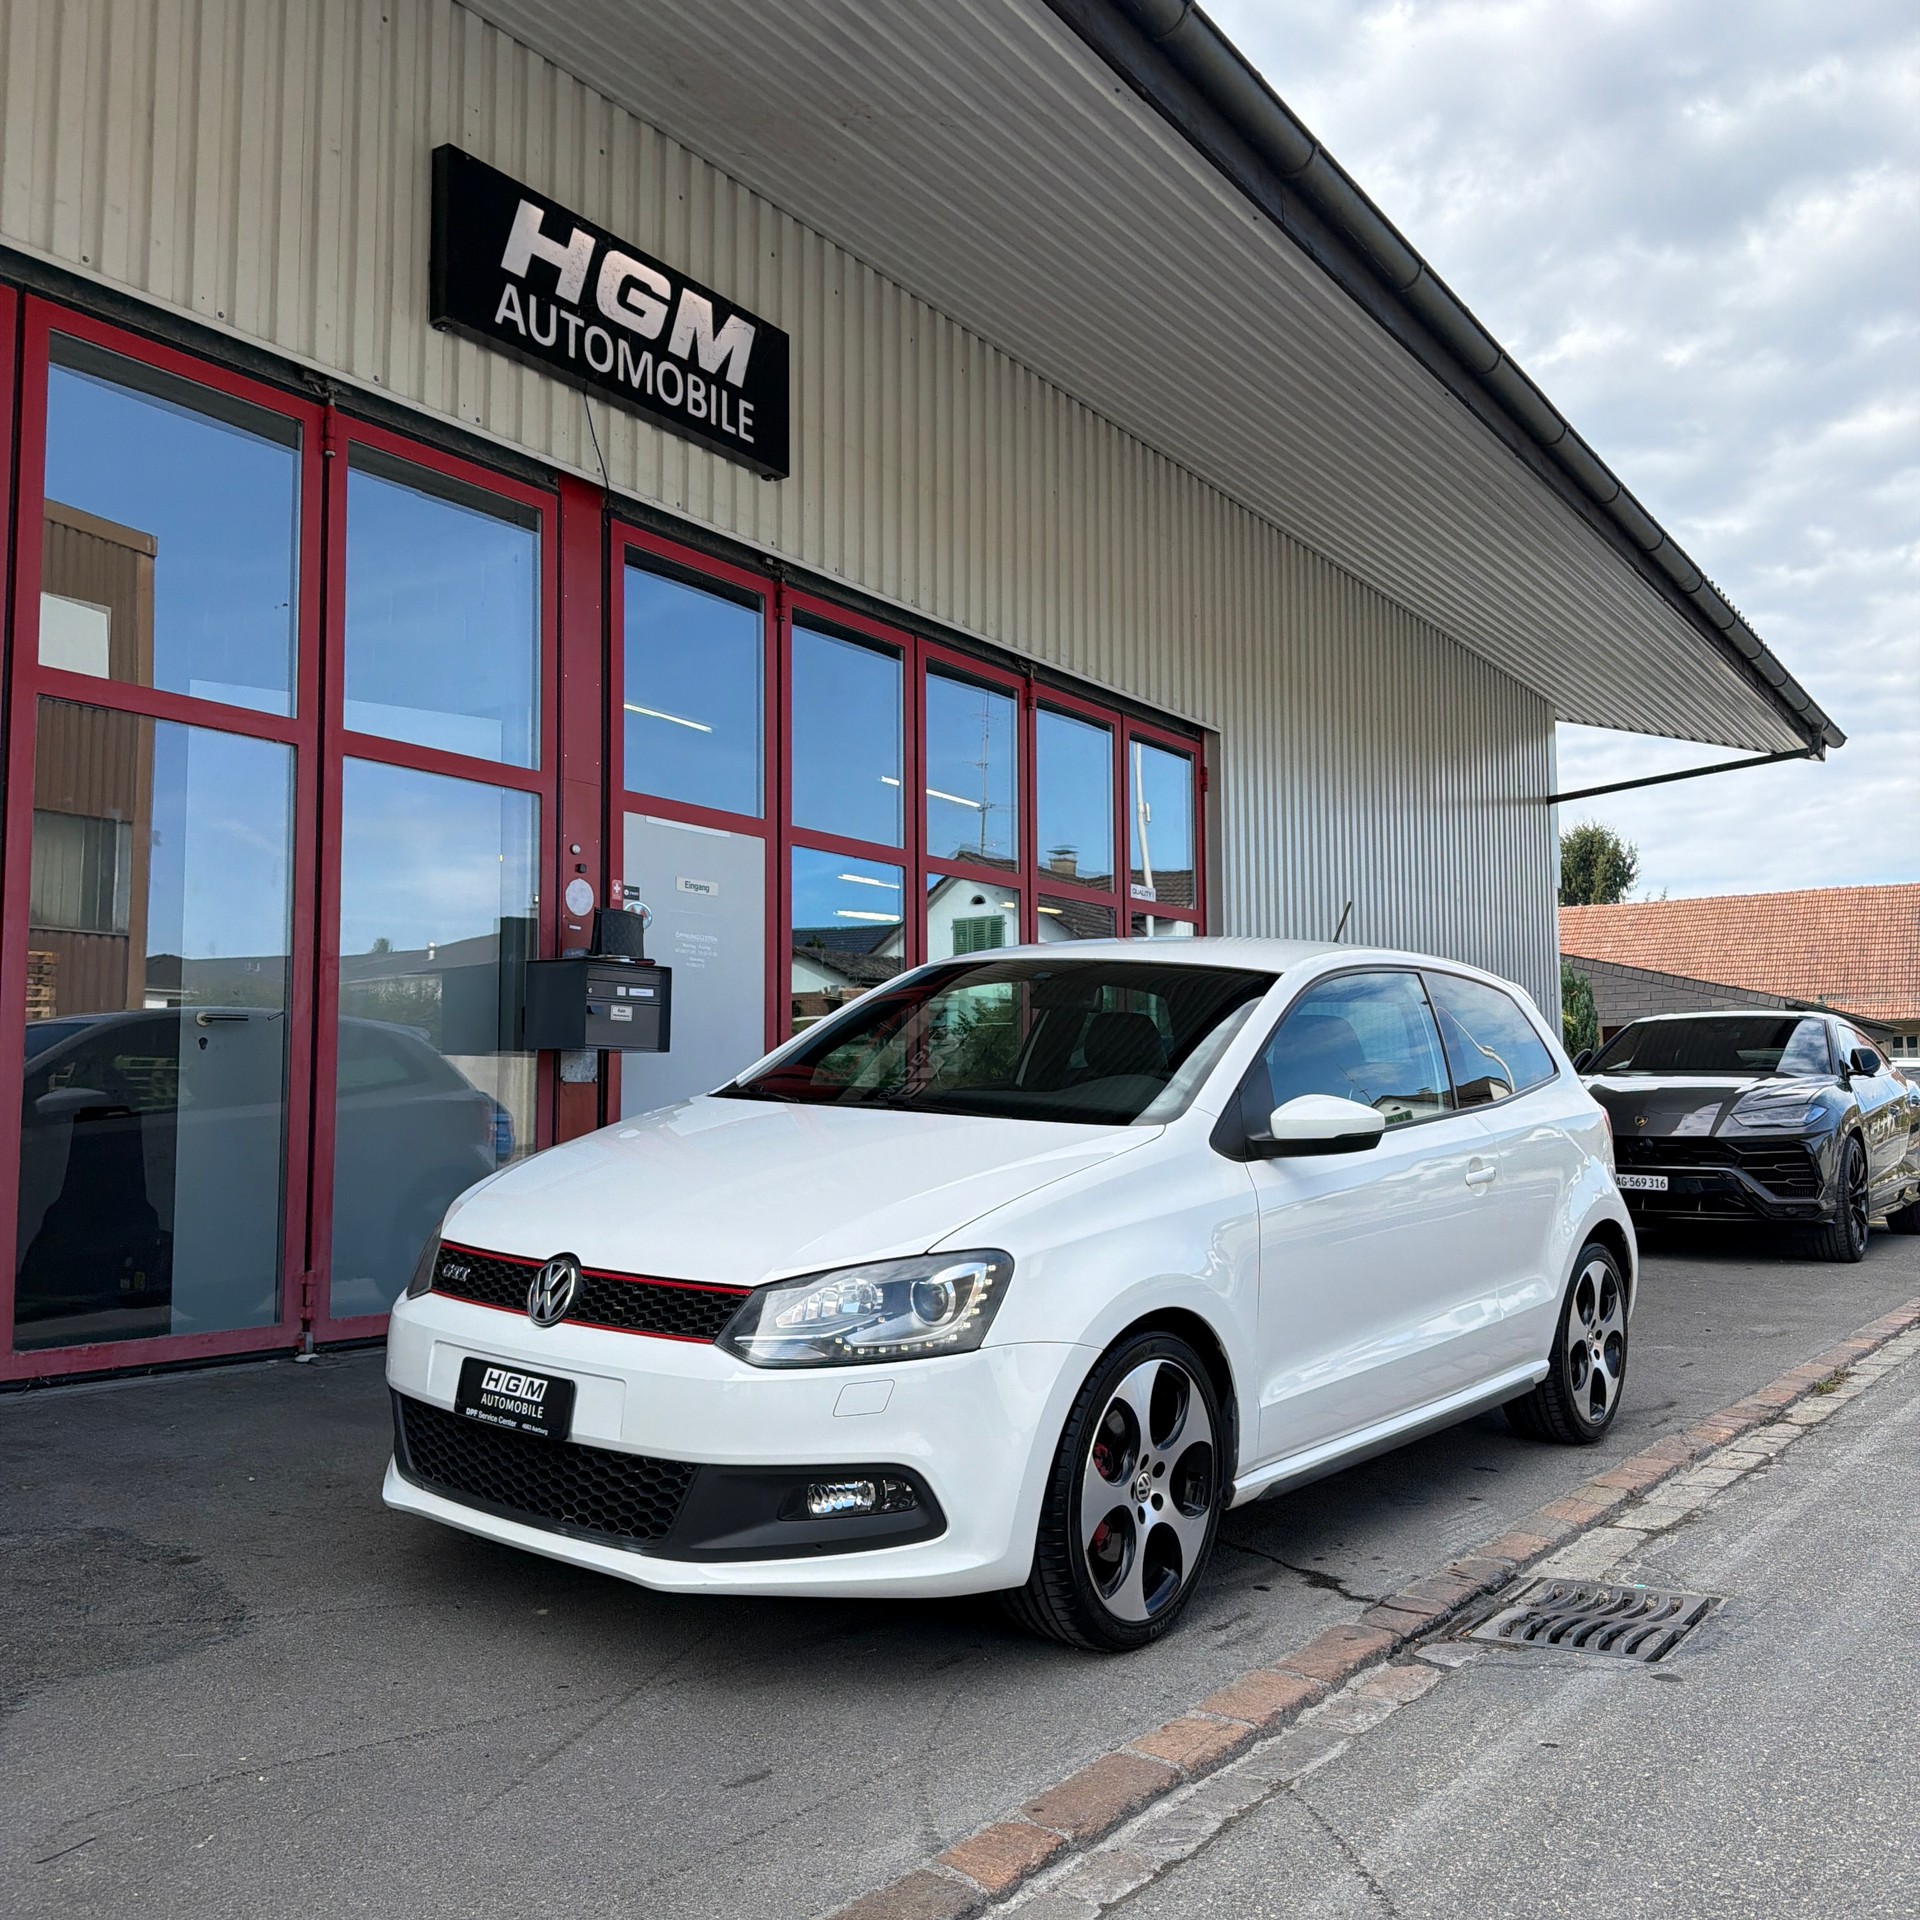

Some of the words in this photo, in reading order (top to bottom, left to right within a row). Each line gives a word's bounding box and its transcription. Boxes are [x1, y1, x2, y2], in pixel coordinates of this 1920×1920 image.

[500, 198, 757, 388] HGM
[494, 282, 755, 444] AUTOMOBILE
[684, 880, 710, 894] Eingang
[1648, 1178, 1667, 1189] 316
[442, 1263, 471, 1282] GTI
[481, 1367, 549, 1402] HGM
[465, 1407, 478, 1417] DPF
[478, 1410, 498, 1423] Service
[498, 1416, 518, 1428] Center
[480, 1392, 545, 1419] AUTOMOBILE
